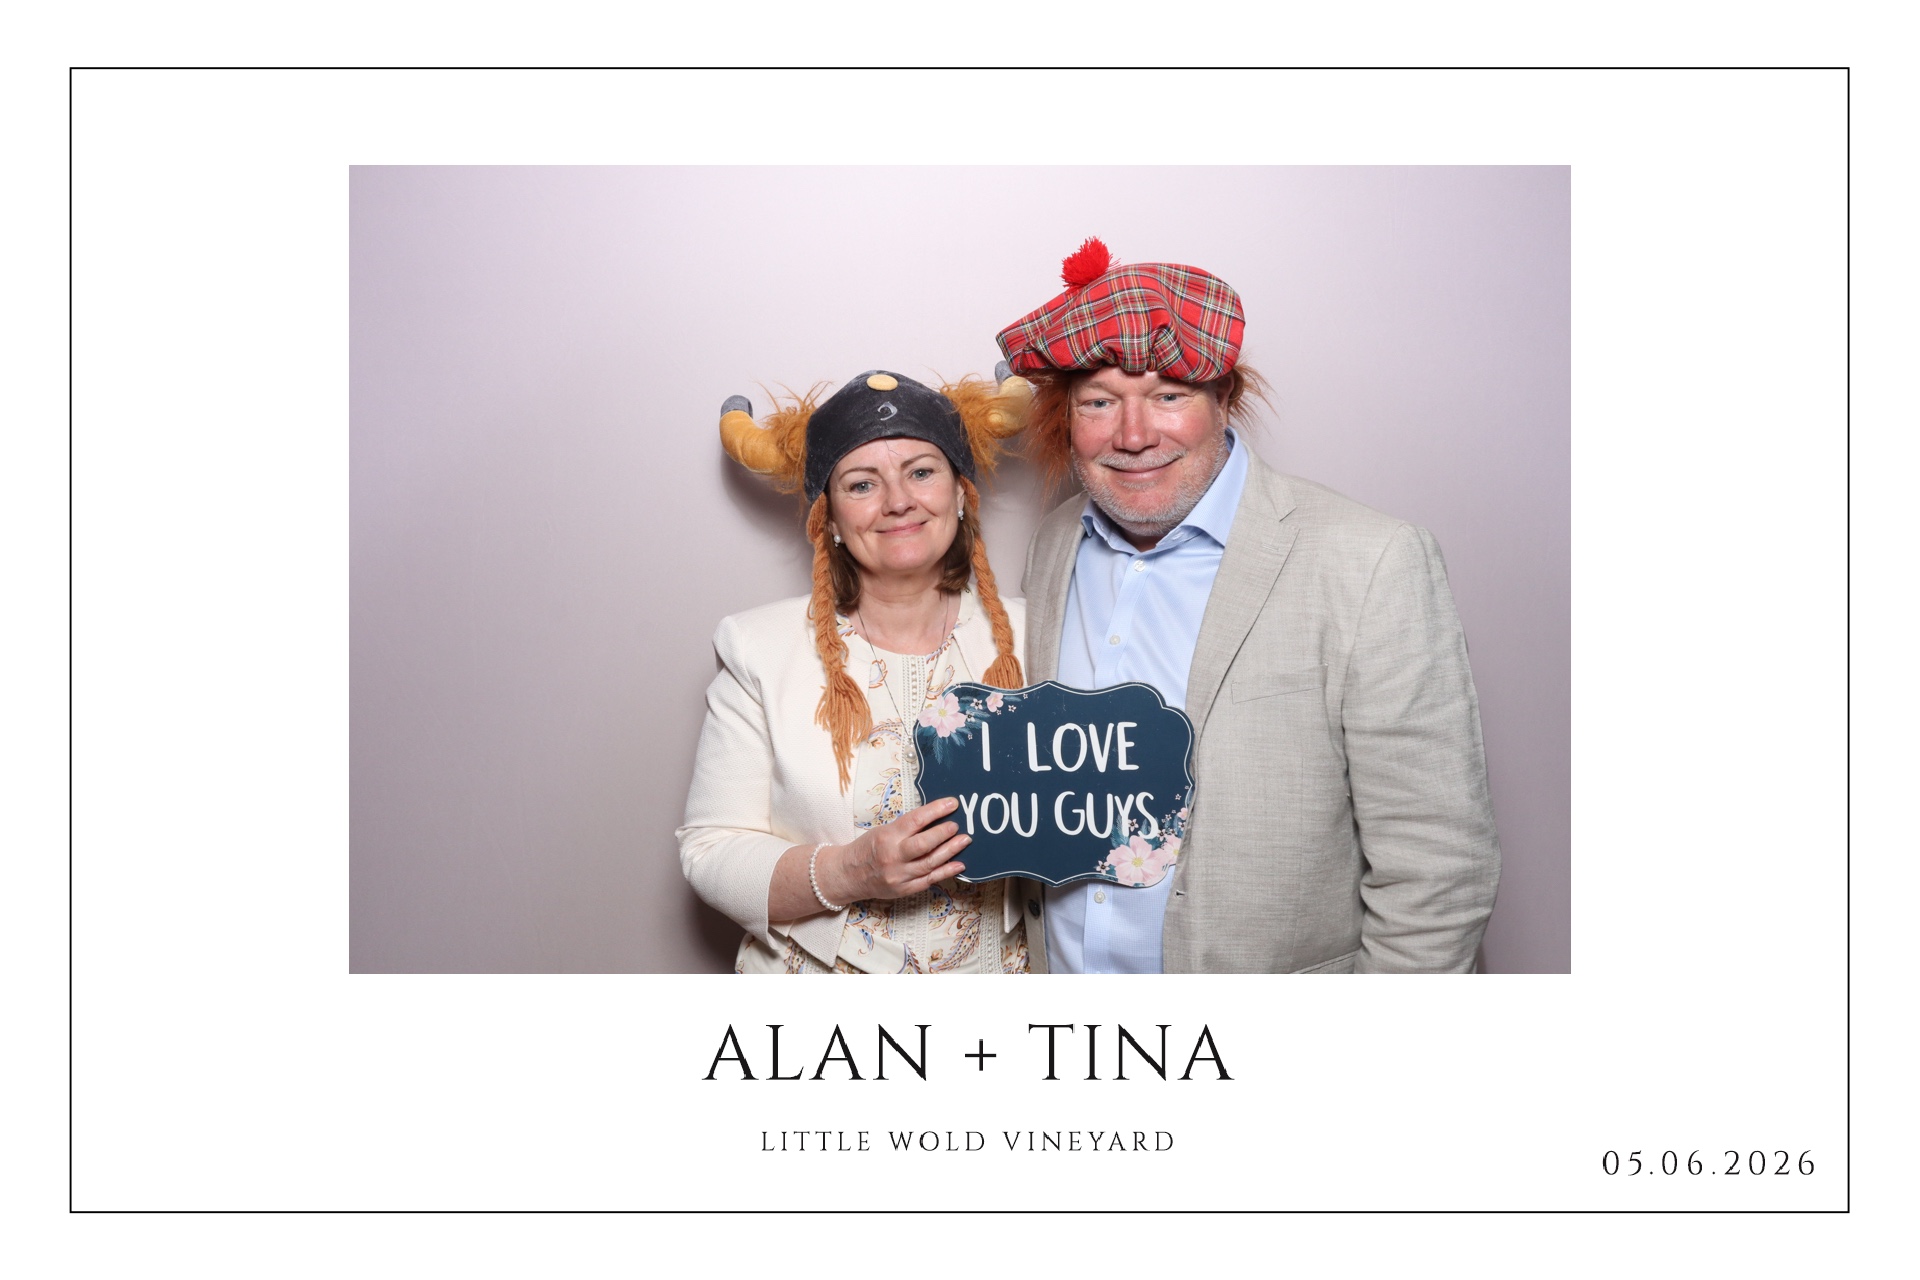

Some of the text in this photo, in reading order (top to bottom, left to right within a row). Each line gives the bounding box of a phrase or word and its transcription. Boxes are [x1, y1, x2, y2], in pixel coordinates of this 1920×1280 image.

[981, 721, 1140, 773] I LOVE
[959, 791, 1160, 840] YOU GUYS
